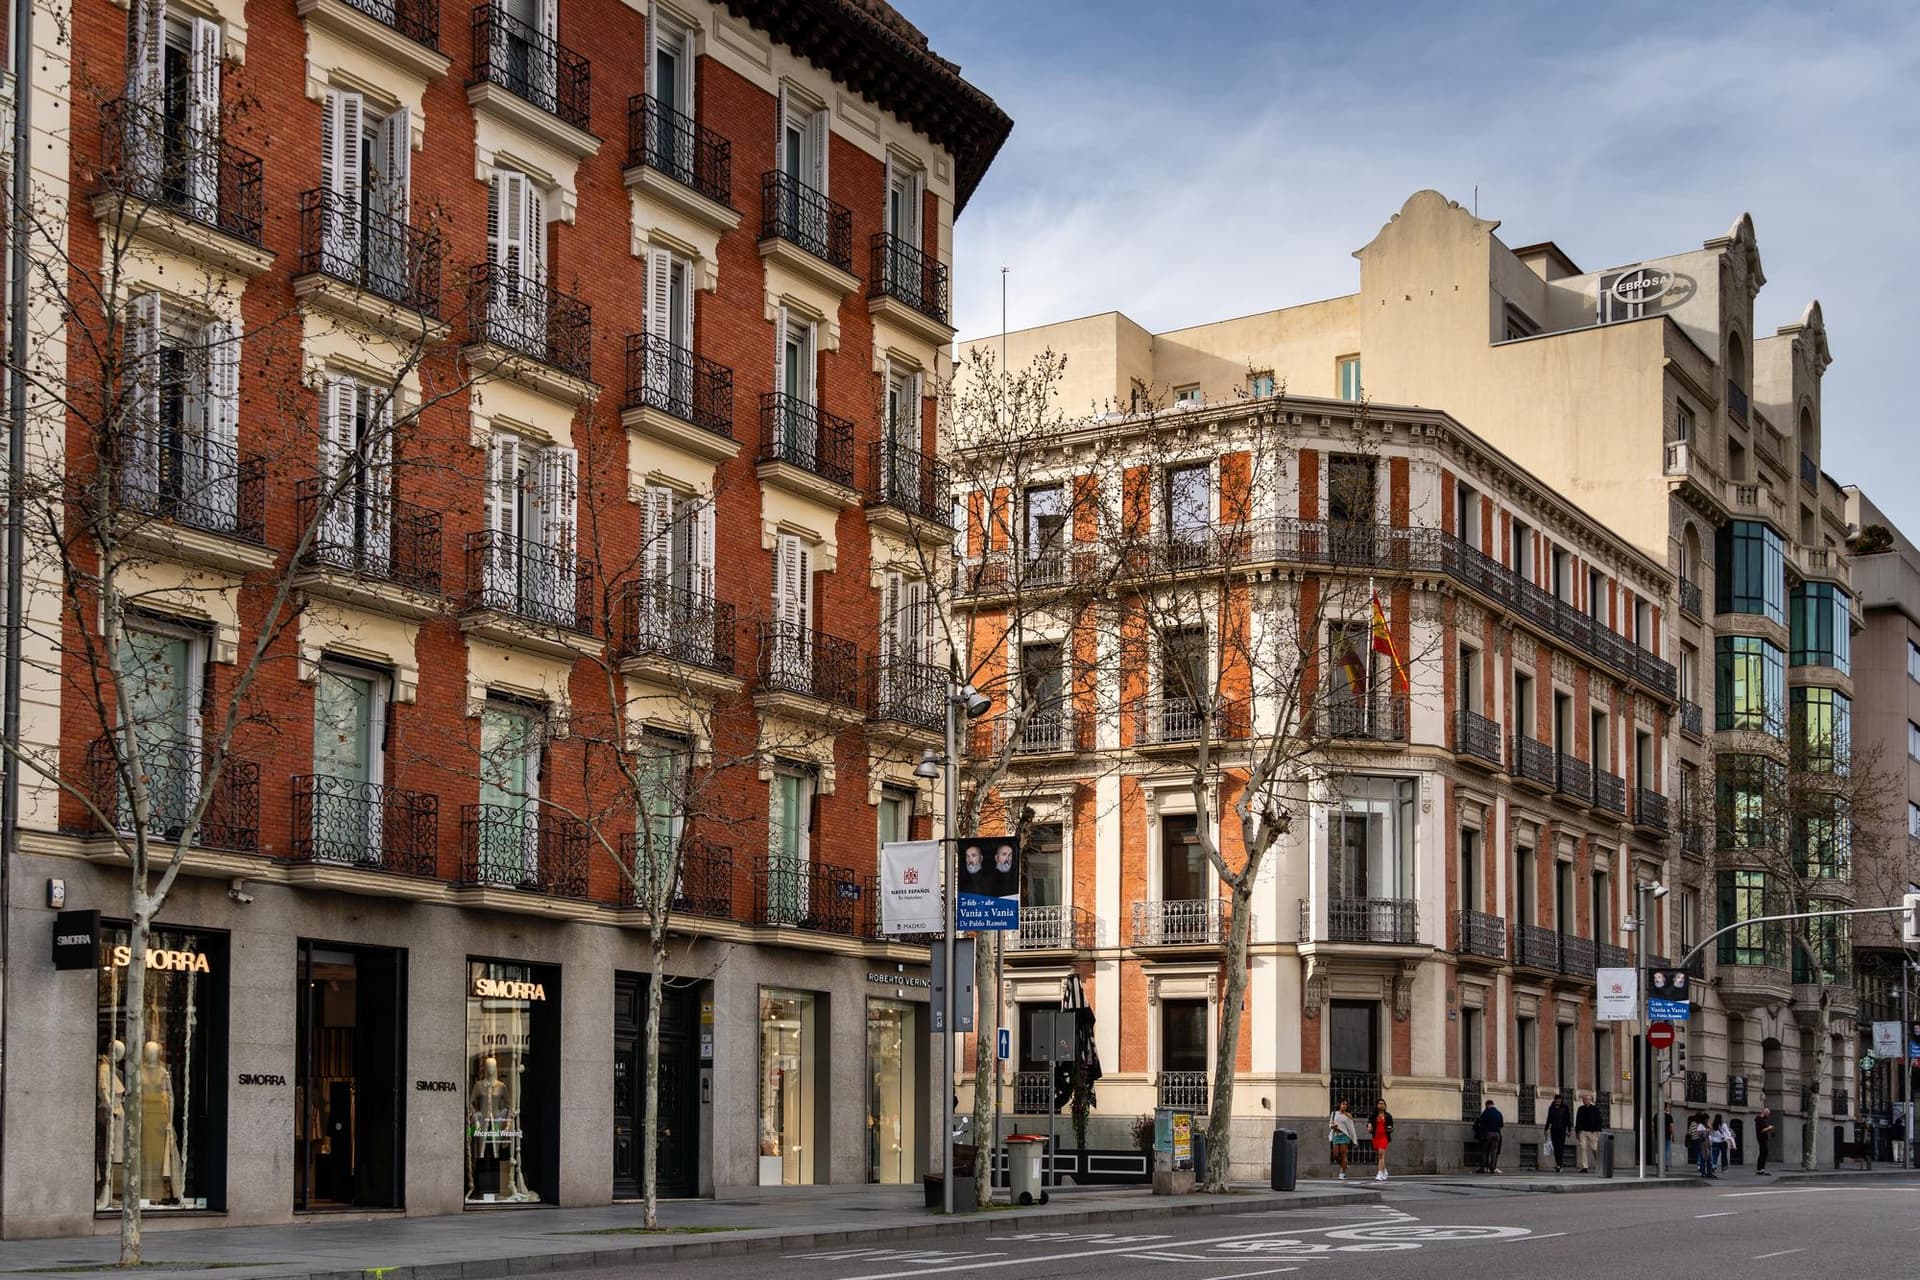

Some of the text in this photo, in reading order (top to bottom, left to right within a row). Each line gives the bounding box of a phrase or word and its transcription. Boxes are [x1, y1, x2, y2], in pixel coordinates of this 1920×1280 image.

[1618, 275, 1668, 293] EBROSA
[960, 908, 982, 917] Vania
[991, 908, 1014, 917] Vania
[57, 934, 91, 946] SIMORRA
[113, 946, 210, 973] SORRA
[868, 973, 904, 984] ROBERTO
[475, 978, 546, 1001] SIMORRA
[238, 1074, 286, 1086] SIMORRA
[416, 1081, 457, 1092] SIMORRA
[985, 1232, 1176, 1244] BUS
[778, 1248, 1009, 1264] TAXI
